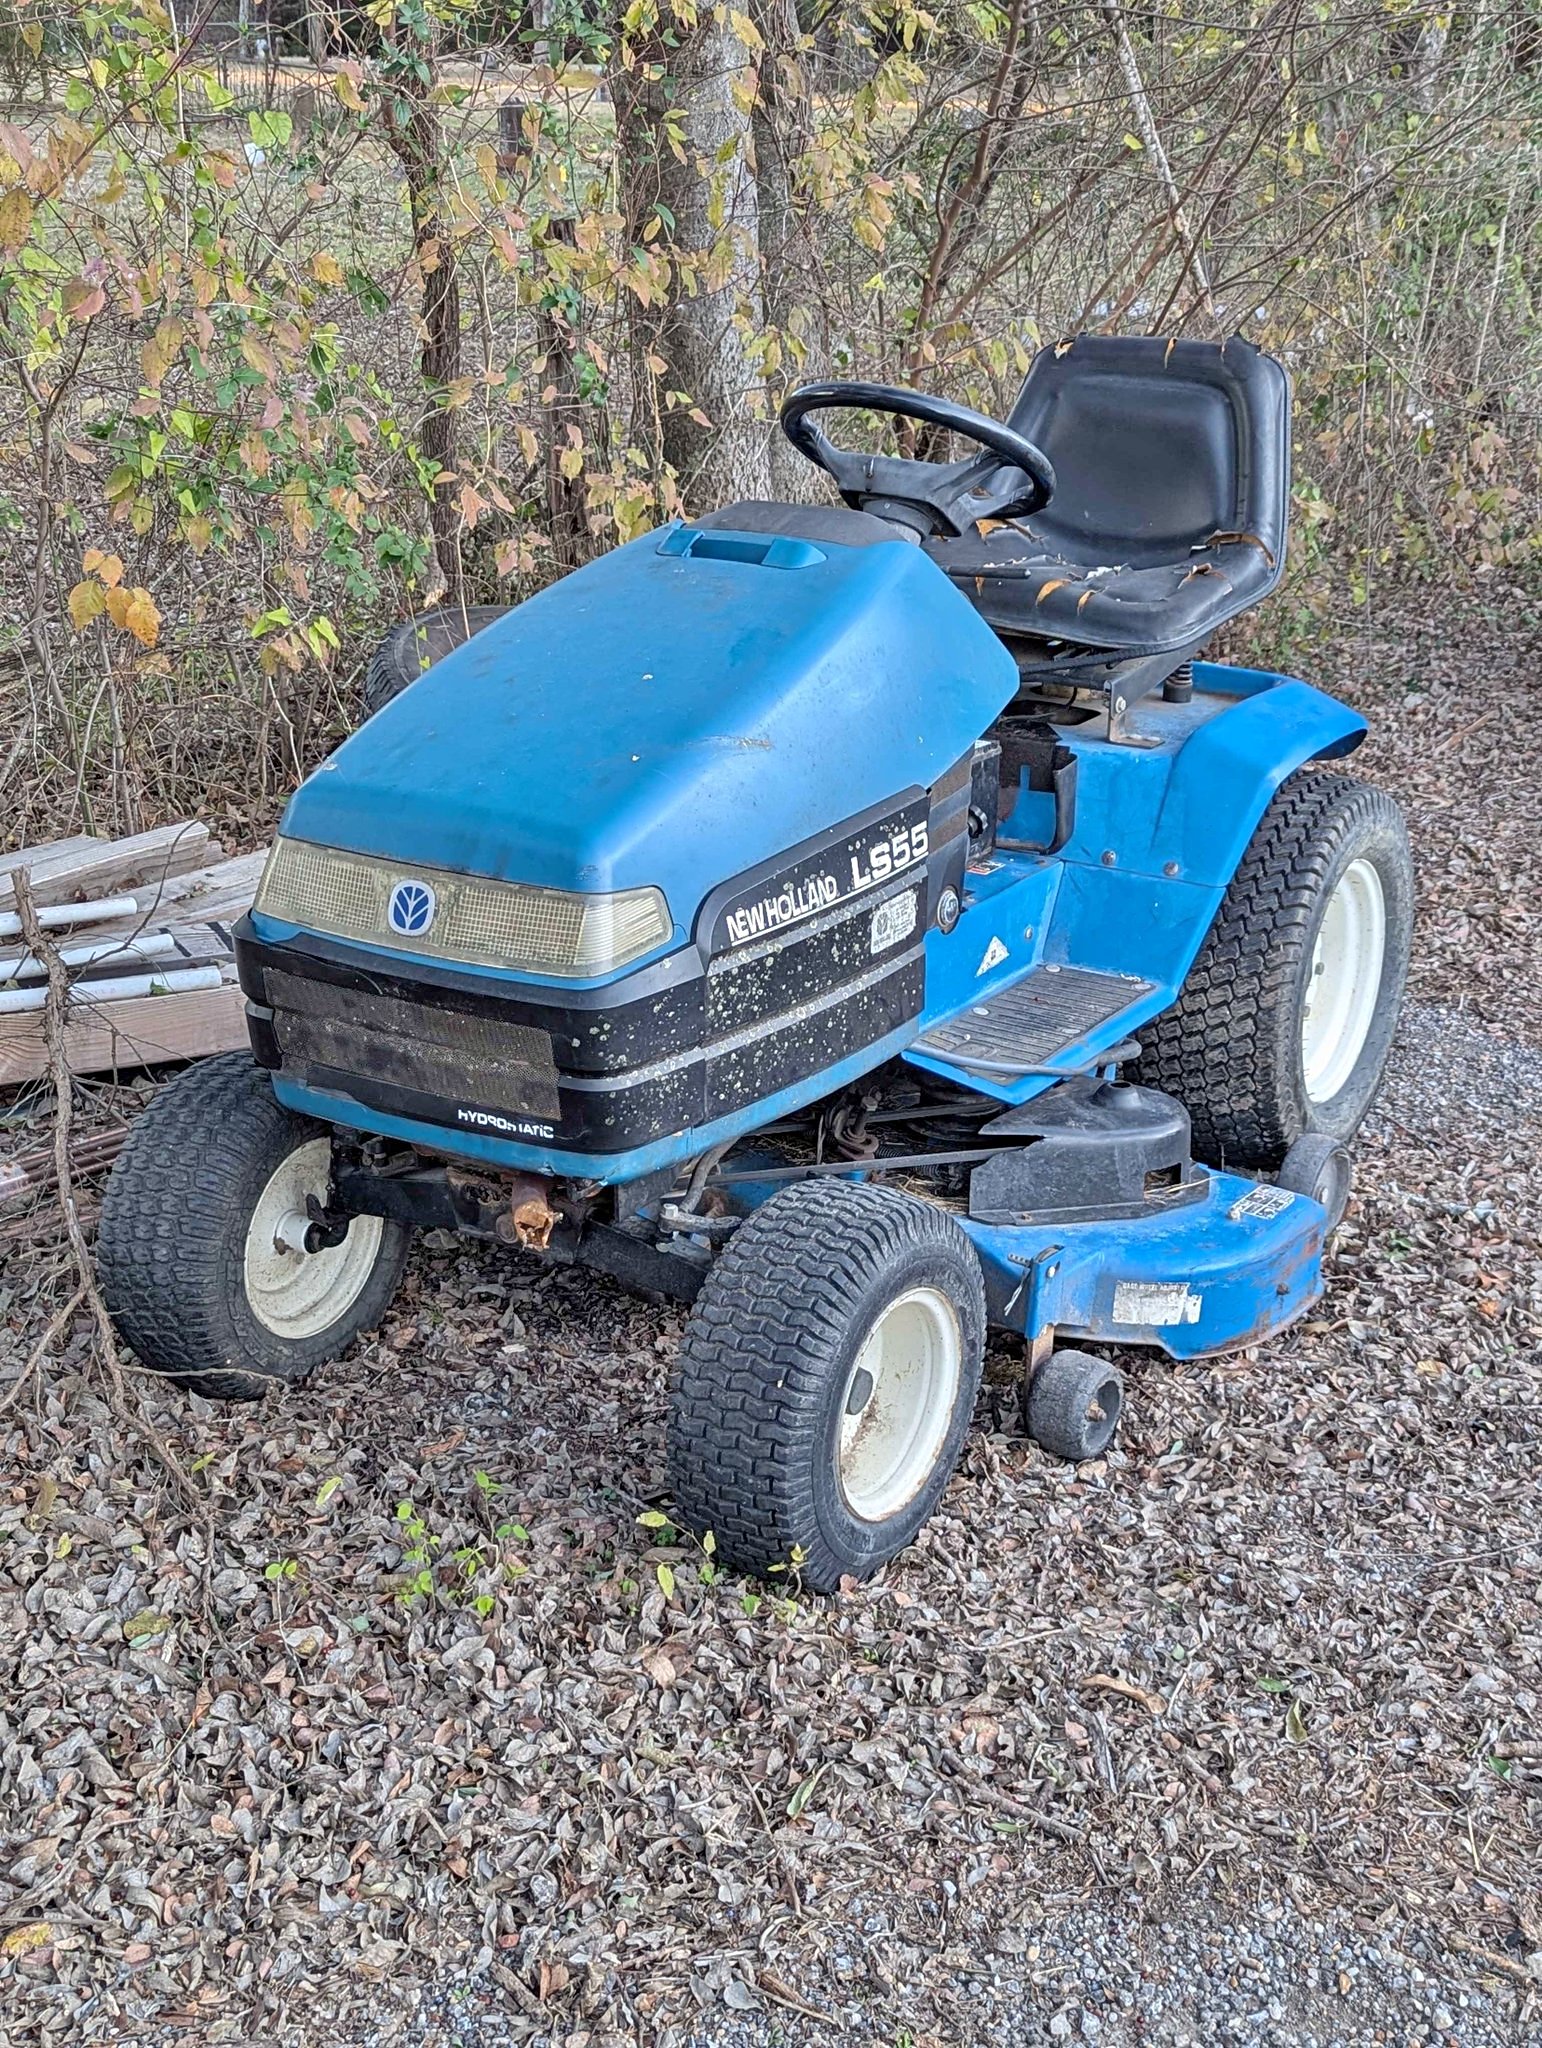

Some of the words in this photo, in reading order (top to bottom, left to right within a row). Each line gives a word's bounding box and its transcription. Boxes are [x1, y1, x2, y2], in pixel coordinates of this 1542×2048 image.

[726, 902, 765, 941] NEW
[765, 875, 837, 926] HOLLAND
[851, 820, 928, 889] LS55
